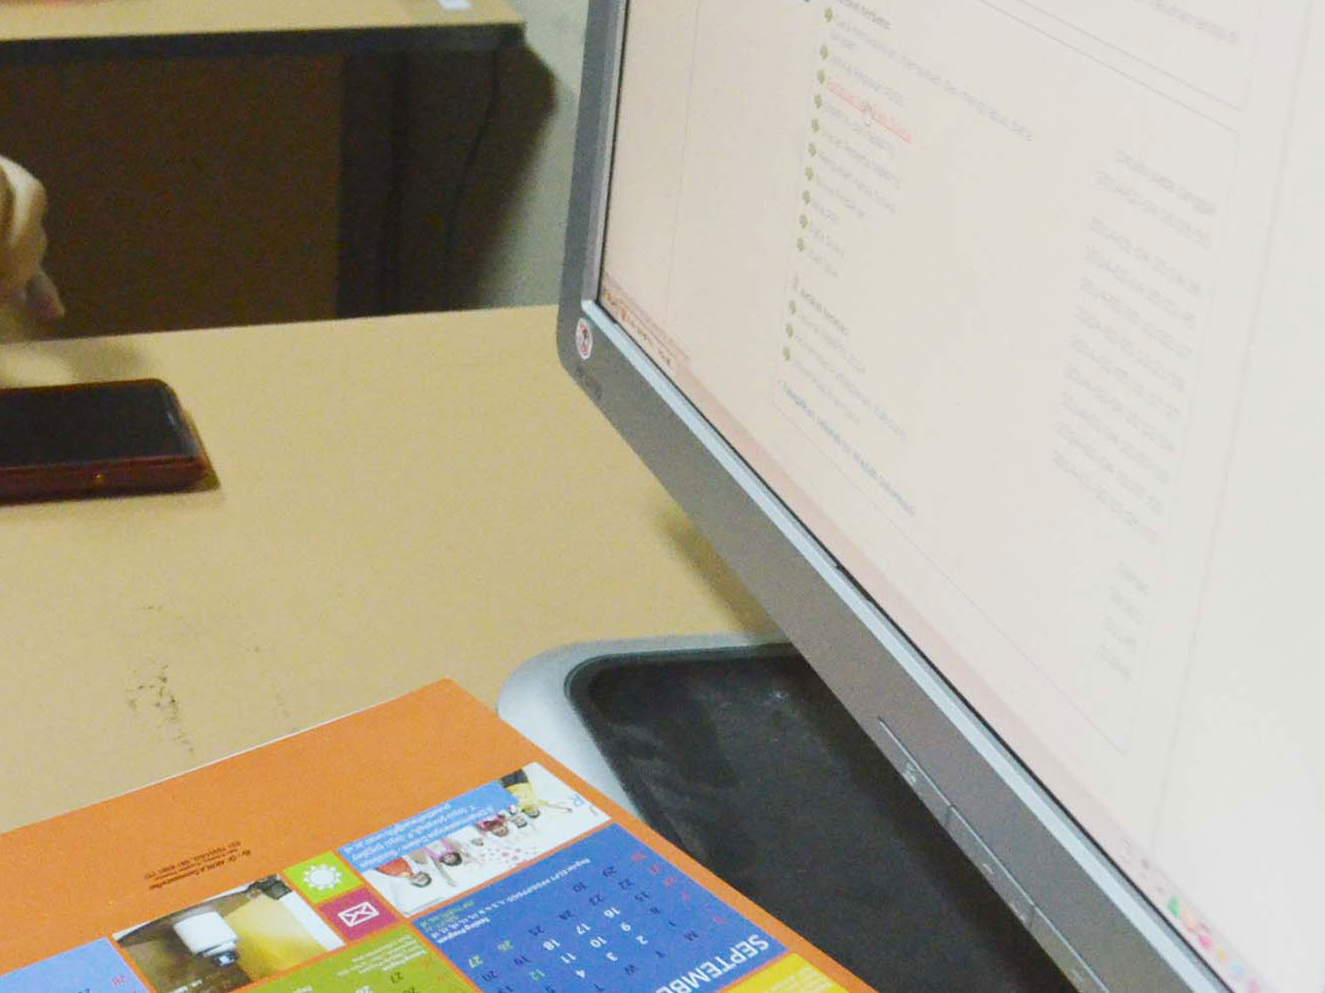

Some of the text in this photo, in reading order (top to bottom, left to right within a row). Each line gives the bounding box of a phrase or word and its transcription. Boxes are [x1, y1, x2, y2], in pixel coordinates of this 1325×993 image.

[603, 906, 620, 917] 16
[574, 923, 591, 934] 17
[543, 939, 560, 950] 18
[589, 936, 607, 947] 10
[466, 955, 484, 967] 27
[560, 952, 576, 963] 11
[654, 933, 769, 993] SEPTEMB
